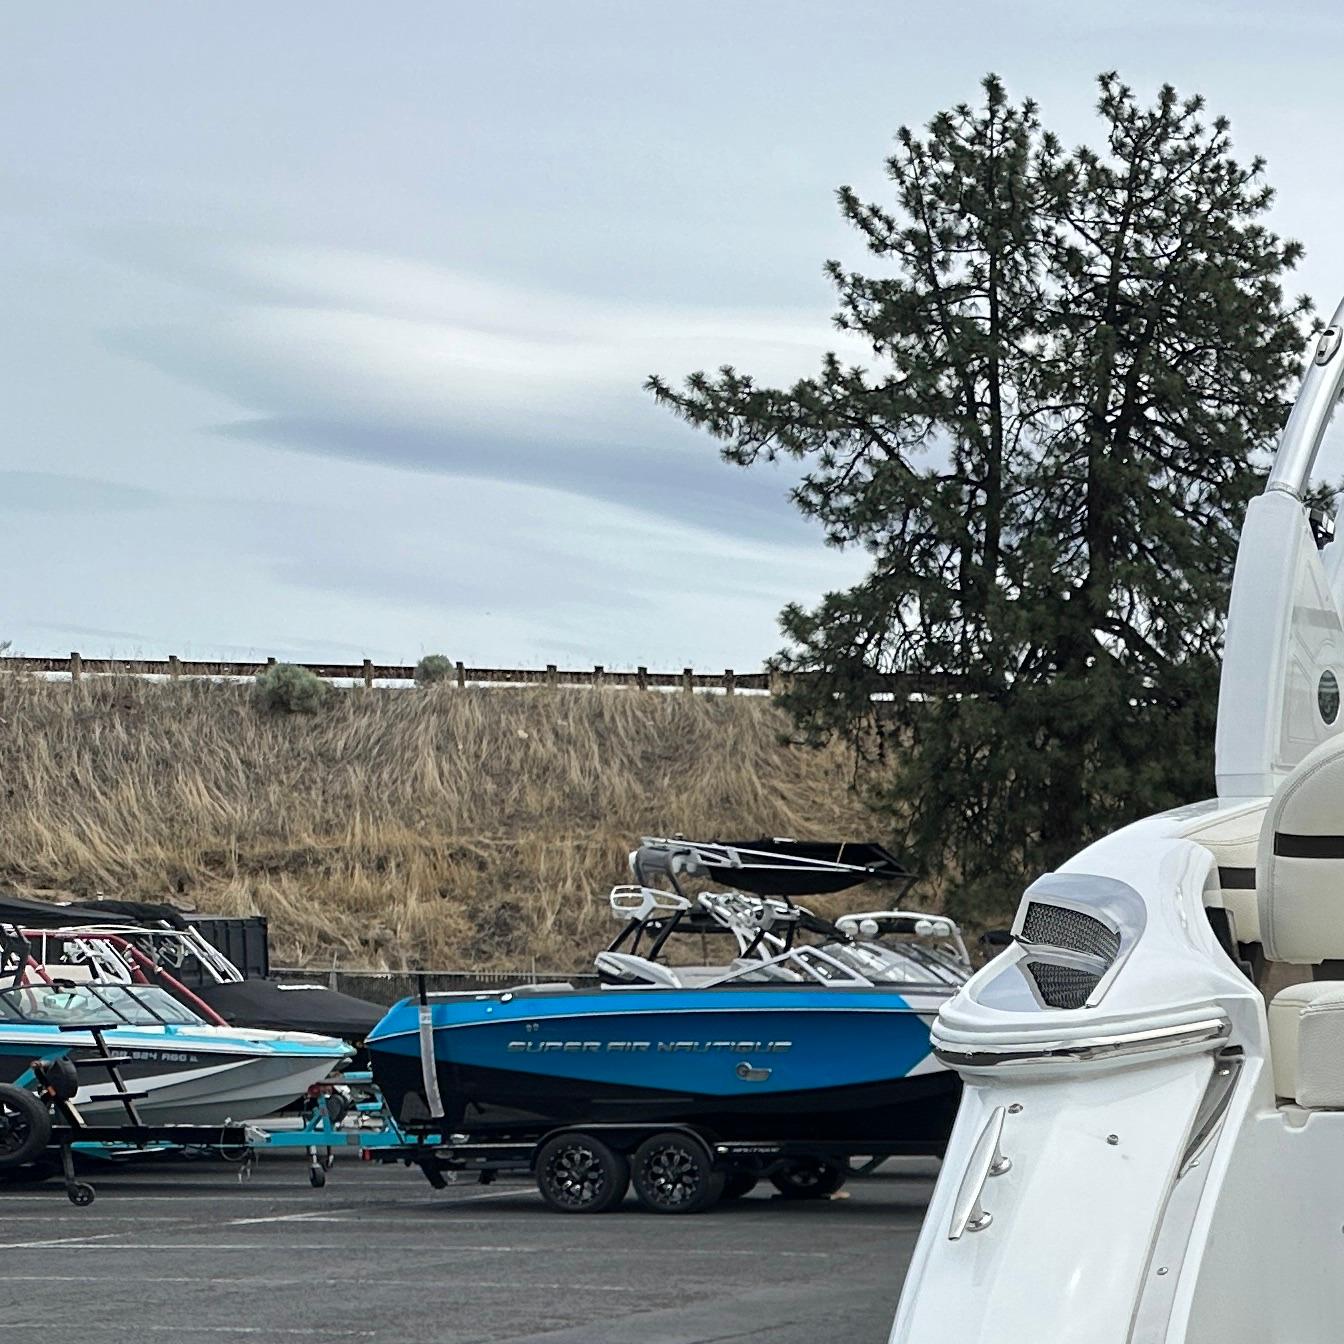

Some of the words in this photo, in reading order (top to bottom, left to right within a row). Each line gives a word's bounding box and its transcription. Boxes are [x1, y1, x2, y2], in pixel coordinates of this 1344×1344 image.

[507, 1041, 601, 1053] SUPER
[606, 1041, 651, 1053] AIR
[657, 1041, 792, 1053] NAUTIQUE
